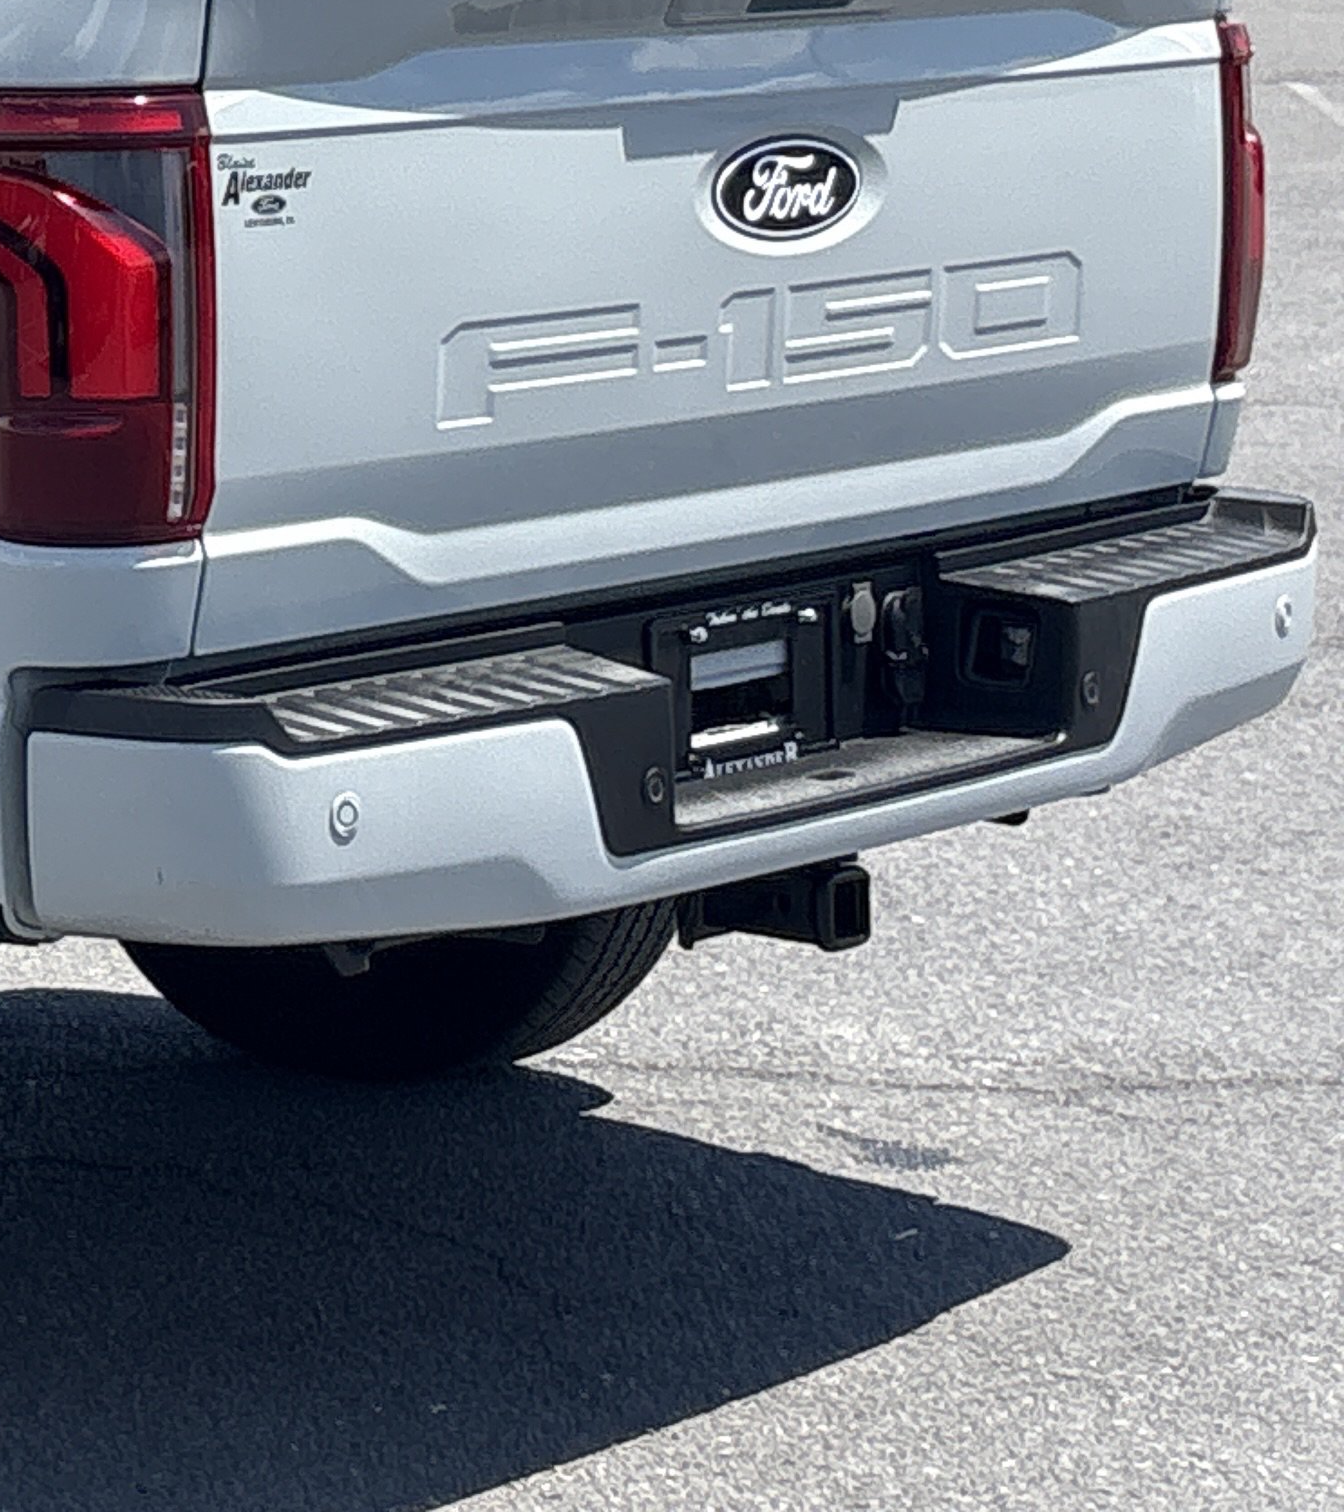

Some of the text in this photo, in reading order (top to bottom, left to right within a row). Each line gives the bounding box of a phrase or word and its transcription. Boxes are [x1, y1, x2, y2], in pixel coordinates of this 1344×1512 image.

[221, 166, 312, 207] Alexander
[743, 155, 837, 221] Ford
[437, 250, 1082, 430] F-150
